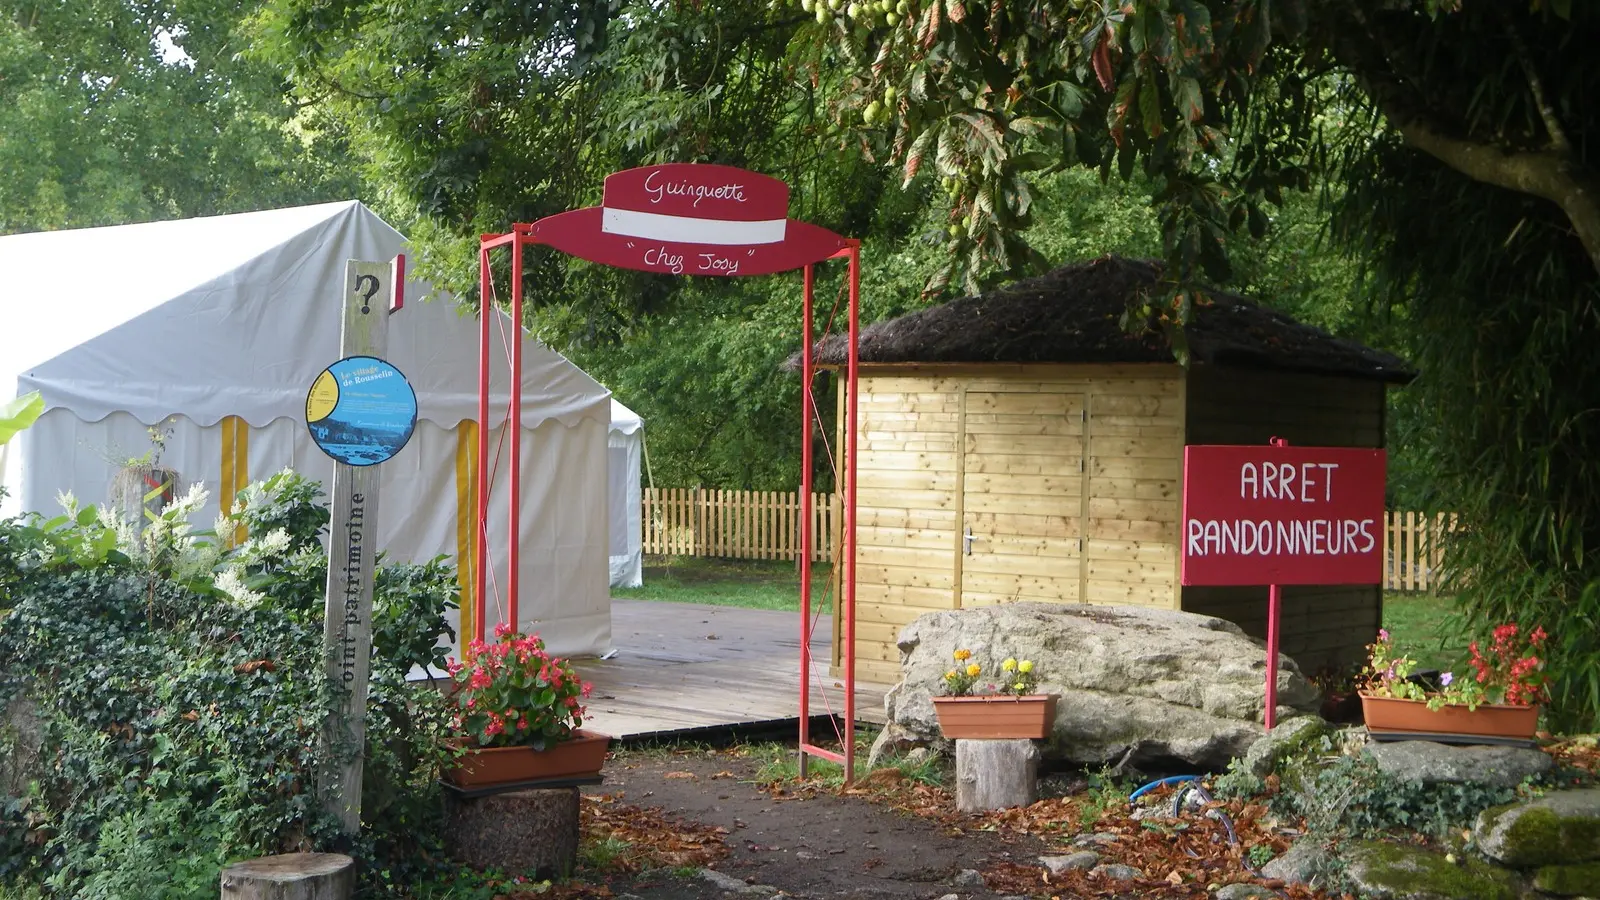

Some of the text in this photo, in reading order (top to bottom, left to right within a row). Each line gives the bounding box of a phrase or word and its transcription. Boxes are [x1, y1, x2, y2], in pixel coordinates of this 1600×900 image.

[644, 170, 747, 208] Guinguette
[343, 379, 353, 387] de
[1240, 461, 1339, 503] ARRET
[1188, 518, 1375, 556] RANDONNEURS
[340, 493, 364, 625] patrimoine
